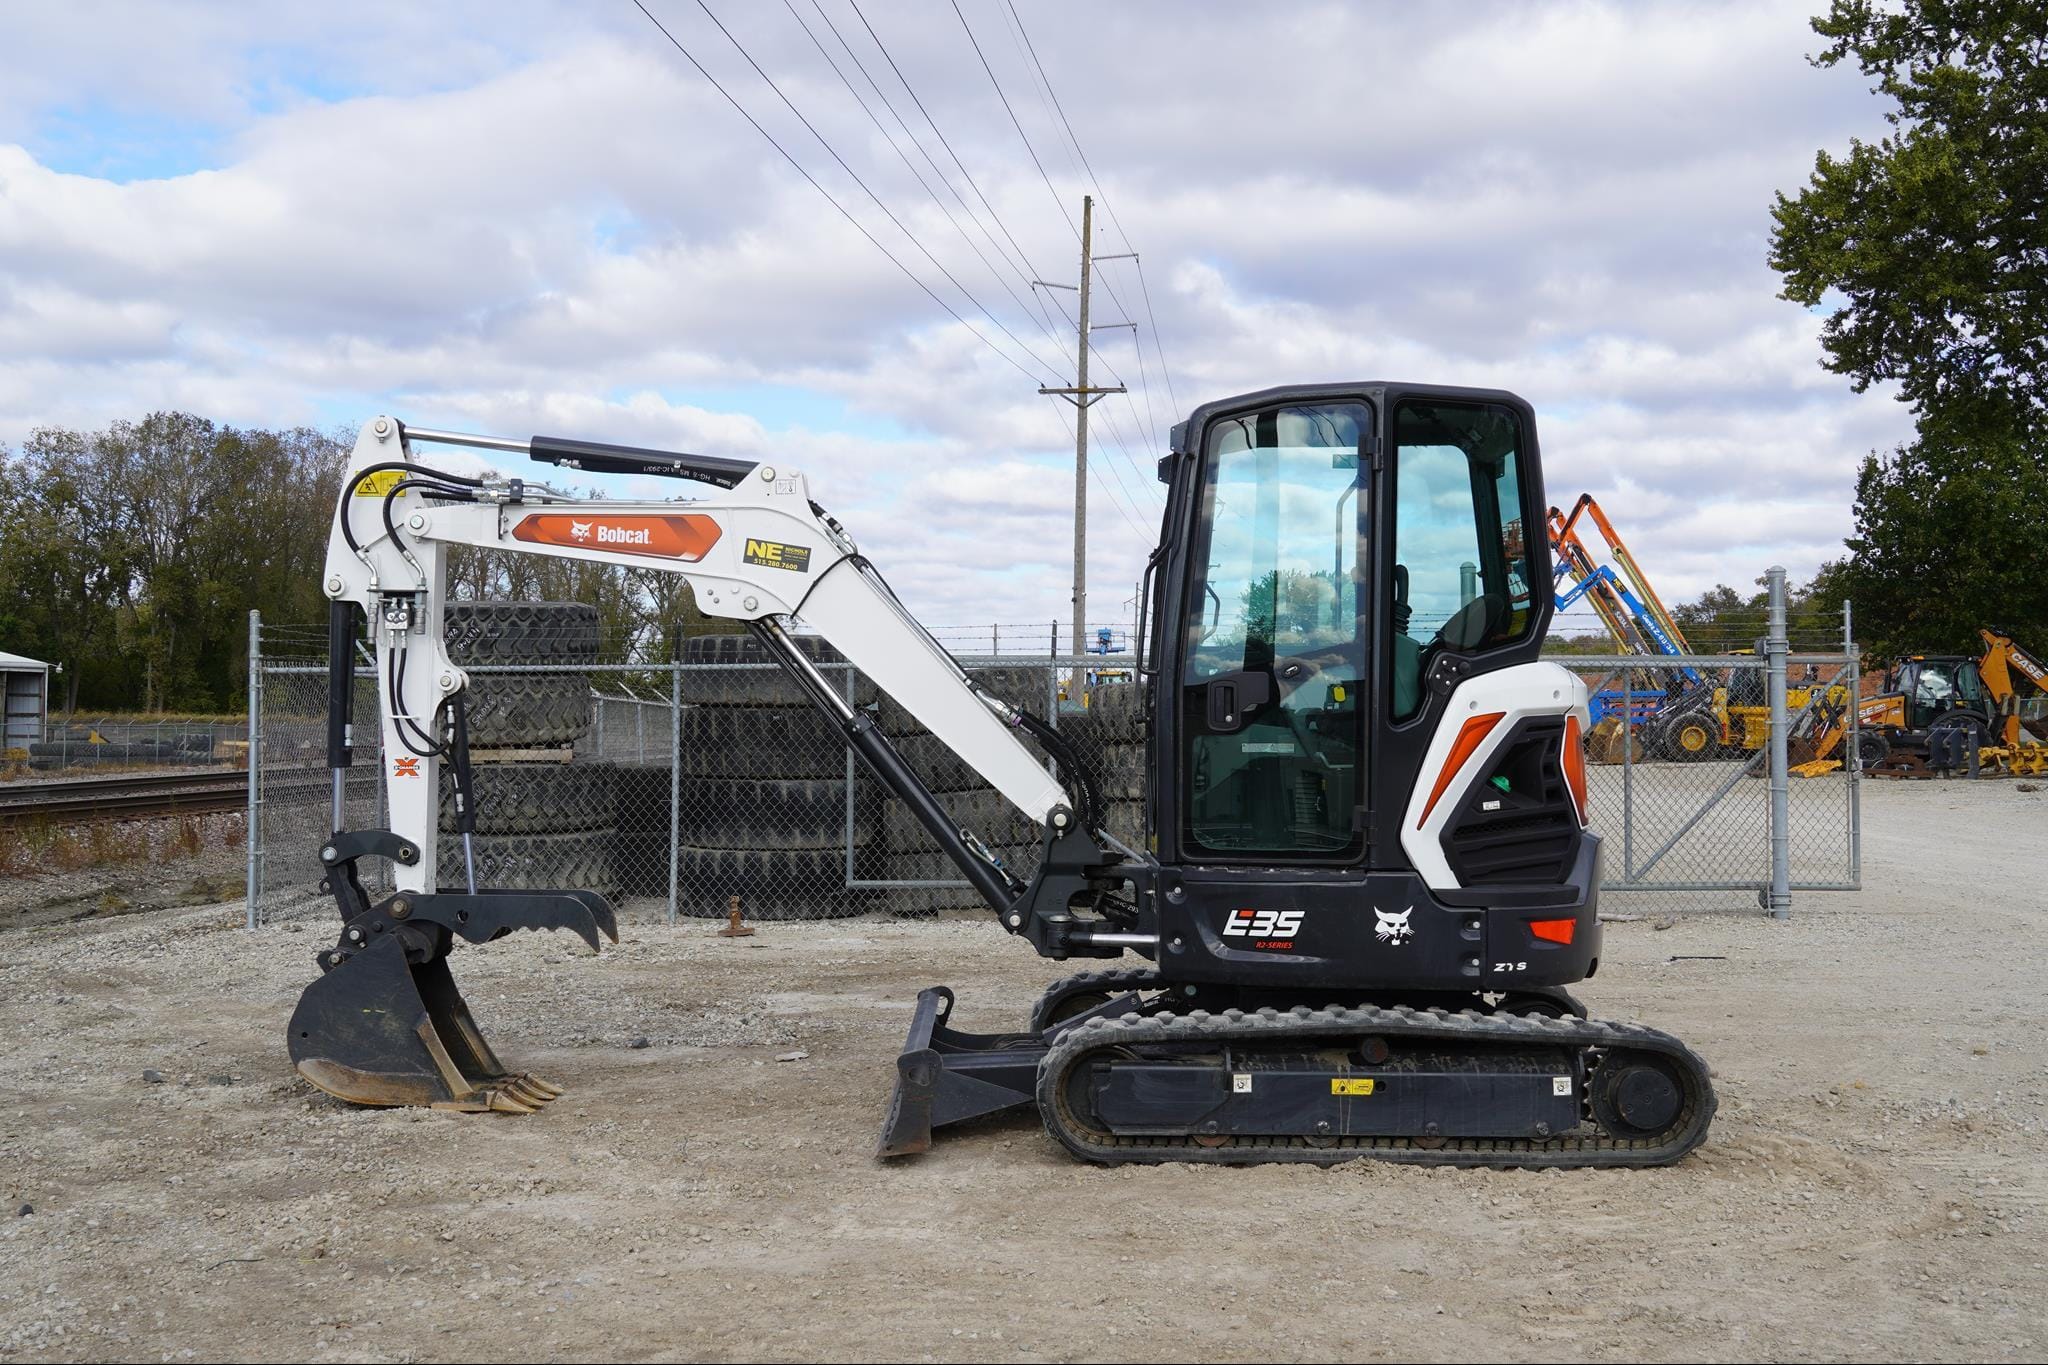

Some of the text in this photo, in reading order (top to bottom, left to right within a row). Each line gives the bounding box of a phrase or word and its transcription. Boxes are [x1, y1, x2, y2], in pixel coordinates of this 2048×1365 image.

[597, 525, 650, 544] Bobcat
[746, 540, 784, 560] NE
[753, 558, 798, 570] 515.280.7600
[2011, 652, 2045, 680] CASE
[1222, 909, 1305, 938] E35
[1255, 941, 1293, 949] R2-SERIES
